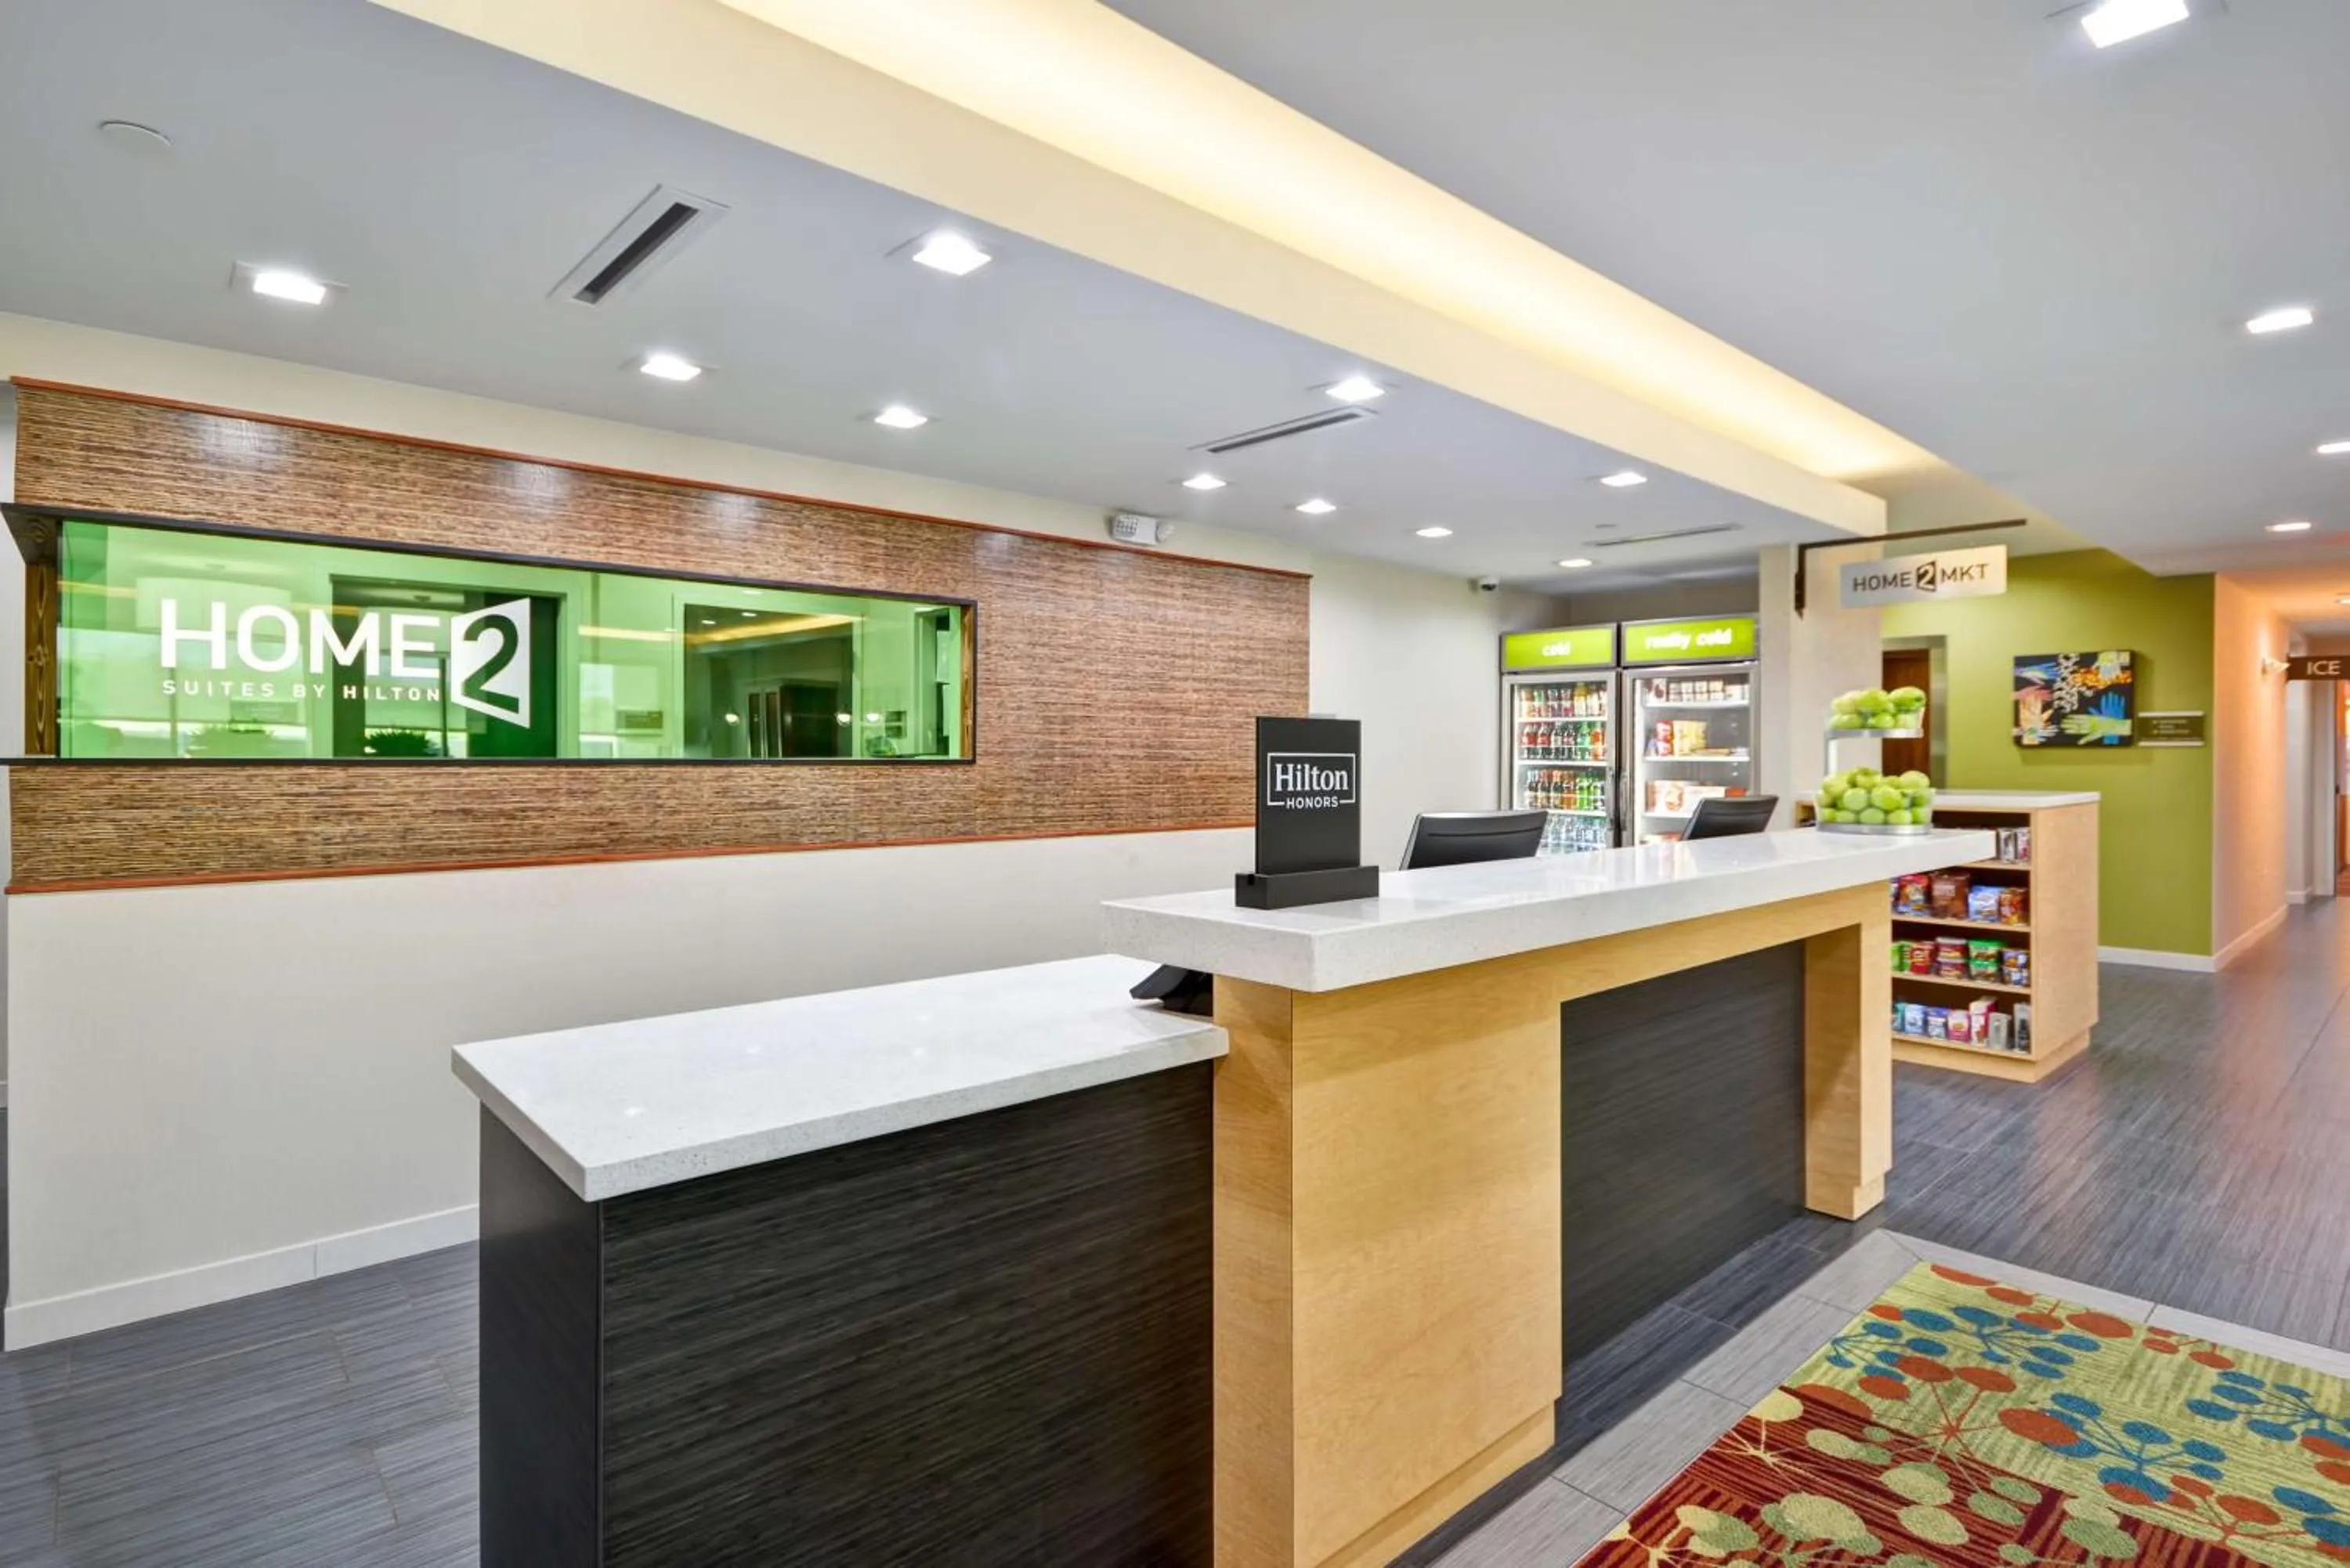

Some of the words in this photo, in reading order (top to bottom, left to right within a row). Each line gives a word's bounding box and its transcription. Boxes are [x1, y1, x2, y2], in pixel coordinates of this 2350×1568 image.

[1852, 570, 1912, 593] HOME
[1940, 562, 1990, 583] MKT
[161, 598, 441, 678] HOME
[1695, 627, 1732, 646] cold
[1542, 641, 1571, 656] cold
[2307, 660, 2341, 675] ICE
[162, 679, 274, 697] SUITES
[292, 683, 326, 699] BY
[342, 685, 440, 701] HILTON
[1274, 762, 1348, 793] Hilton
[1285, 796, 1339, 809] HONORS
